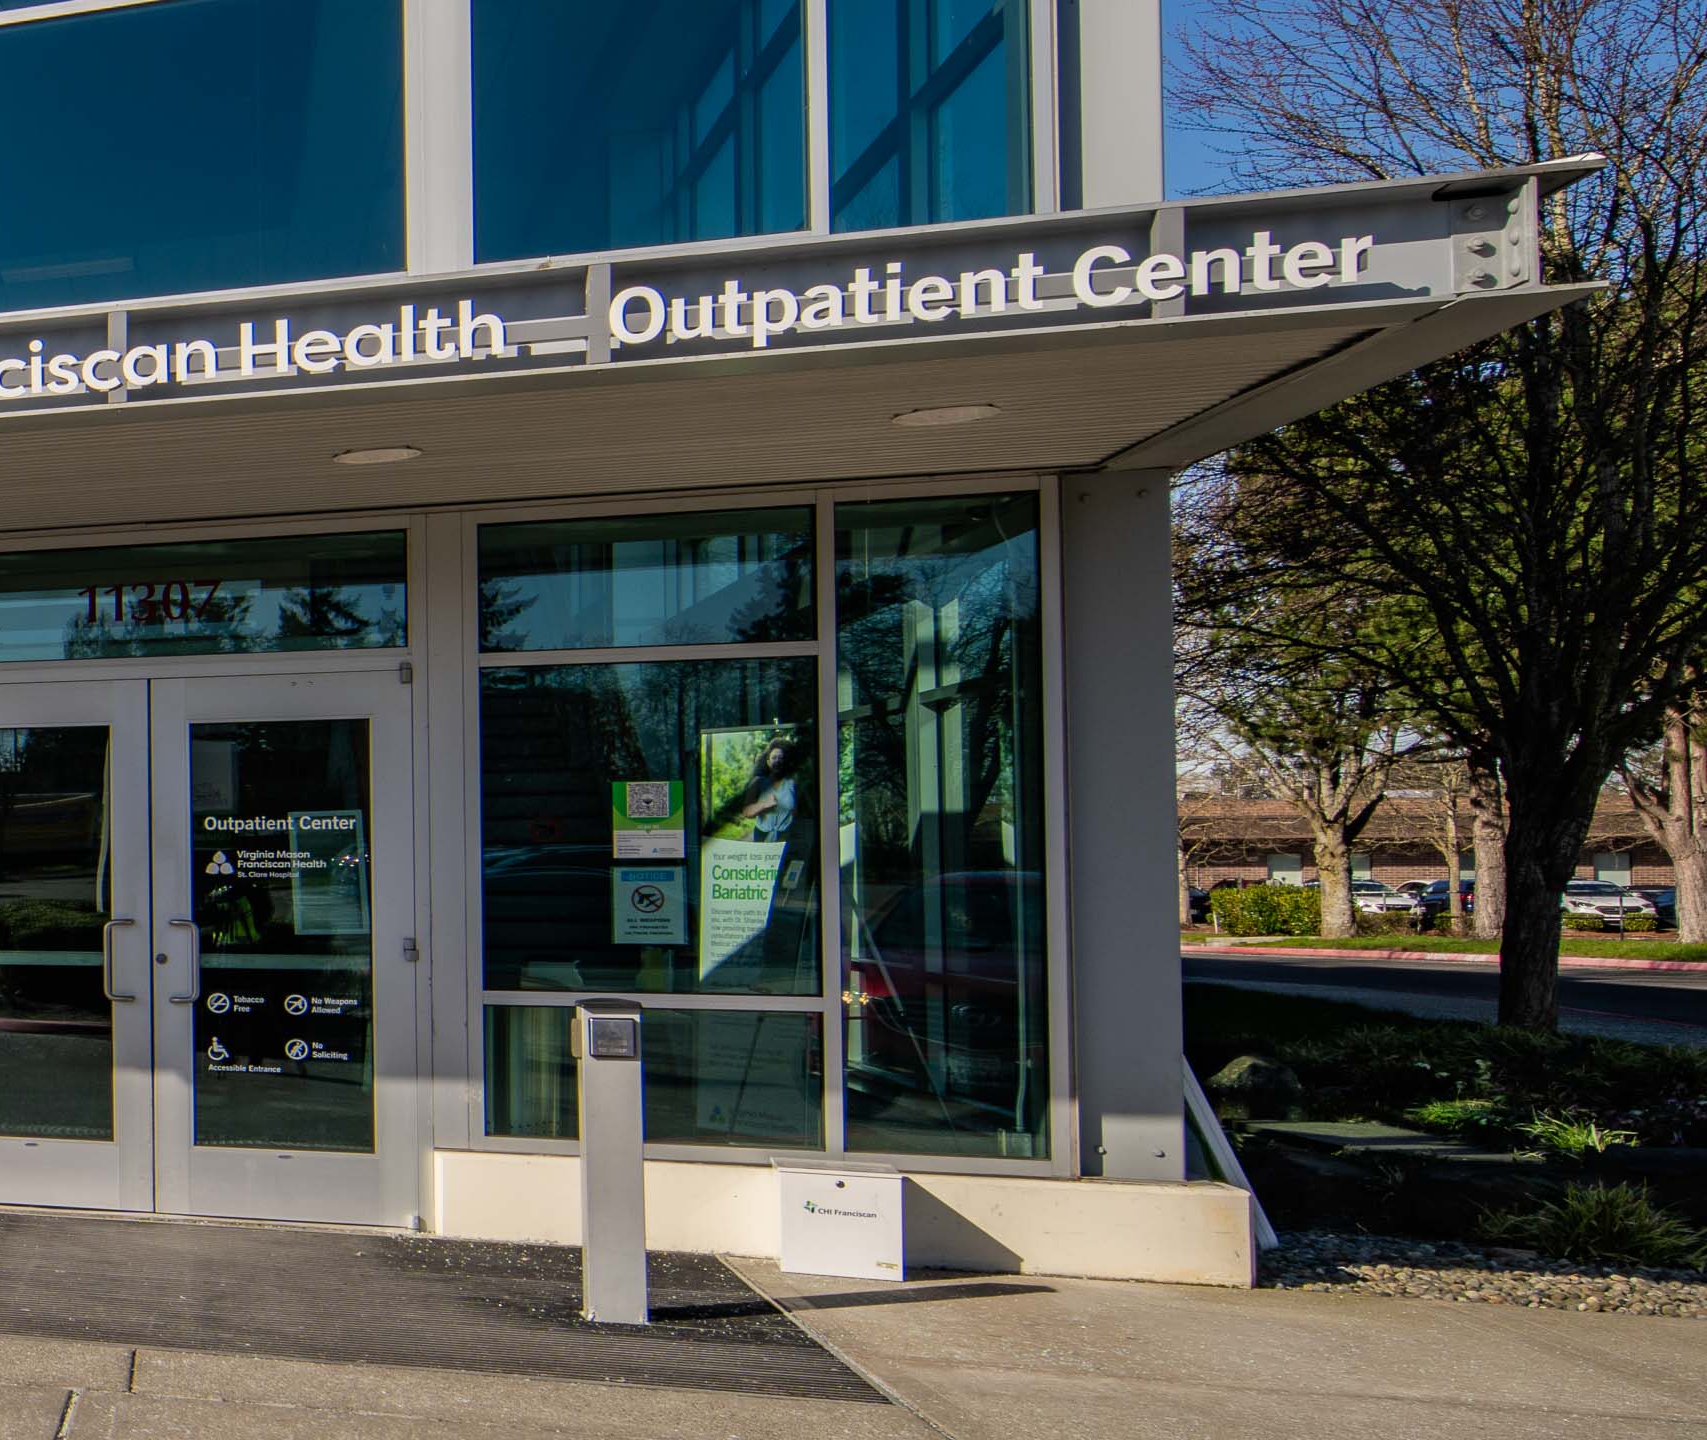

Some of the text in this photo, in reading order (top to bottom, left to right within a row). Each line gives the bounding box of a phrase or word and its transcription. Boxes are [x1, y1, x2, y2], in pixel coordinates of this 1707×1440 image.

[609, 231, 1373, 347] Outpatient Center
[241, 300, 504, 376] Health
[79, 579, 222, 623] 11307
[204, 815, 357, 833] Outpatient Center
[237, 850, 311, 860] Virginia Mason
[238, 859, 327, 869] Franciscan Health
[712, 884, 768, 900] Bariatric
[233, 995, 264, 1003] Tobacco
[324, 997, 358, 1006] Weapons
[312, 1051, 348, 1060] Soliciting
[208, 1064, 281, 1073] Accessible Entrance
[834, 1209, 877, 1218] Franciscan
